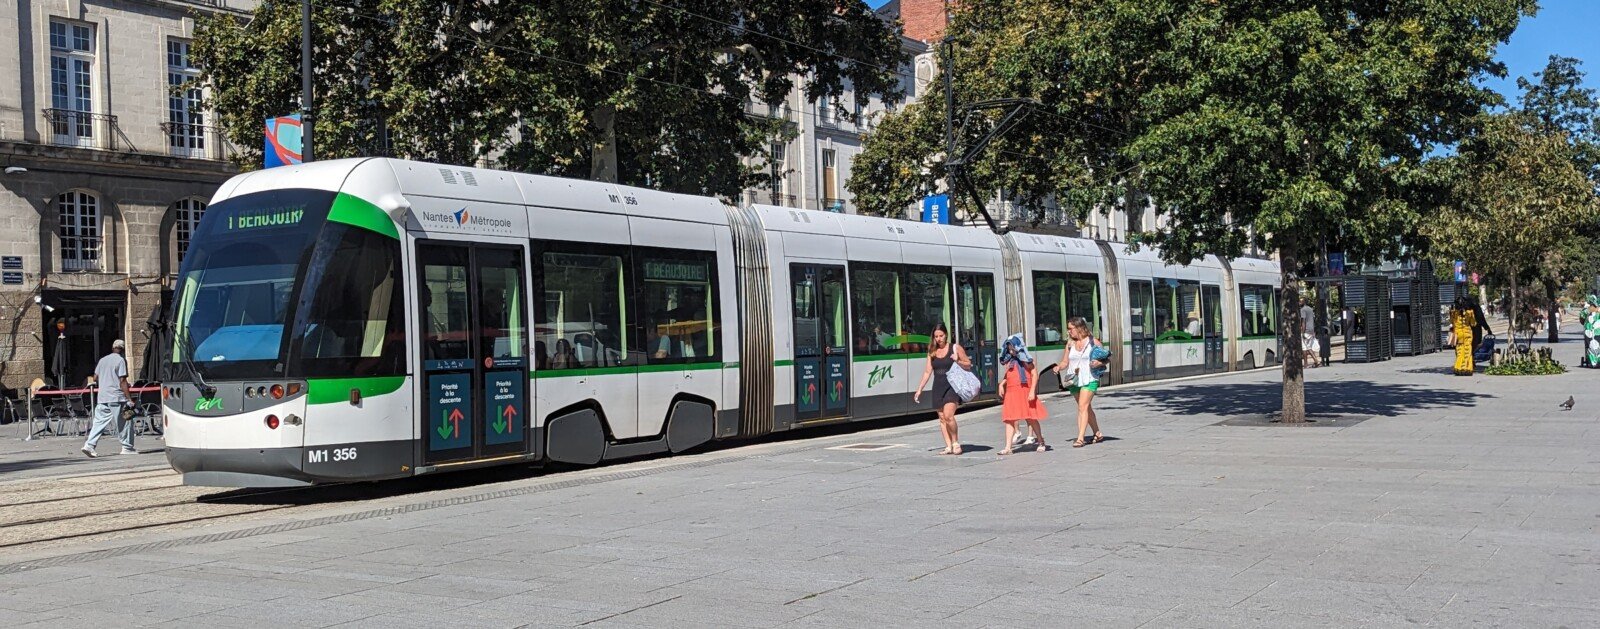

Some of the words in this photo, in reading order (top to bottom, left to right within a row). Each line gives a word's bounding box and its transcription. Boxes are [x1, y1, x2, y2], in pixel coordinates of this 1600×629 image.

[608, 194, 620, 204] M1
[624, 196, 638, 206] 356
[422, 211, 454, 223] Nantes
[470, 215, 512, 228] Métropole
[867, 364, 894, 389] tan
[441, 383, 459, 391] Priorité
[308, 450, 328, 463] M1
[333, 447, 357, 462] 356
